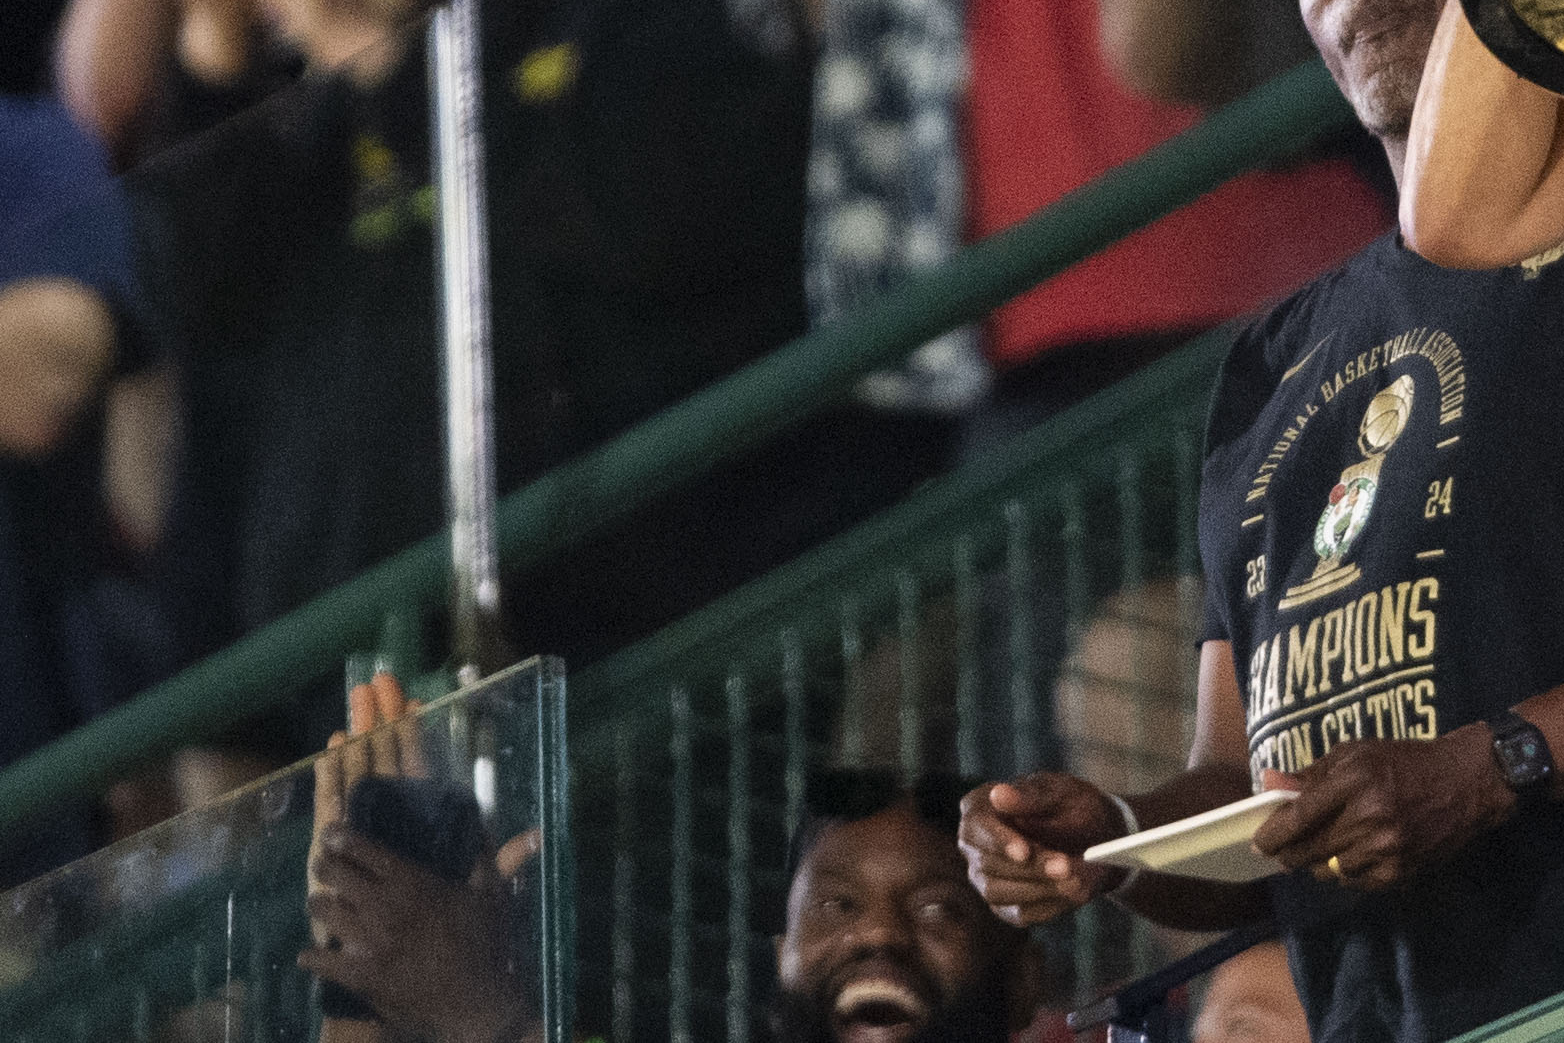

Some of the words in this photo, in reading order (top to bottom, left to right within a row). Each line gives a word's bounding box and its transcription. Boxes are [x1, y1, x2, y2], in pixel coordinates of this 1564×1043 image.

[1245, 403, 1319, 502] NATIONAL
[1320, 327, 1428, 403] BASKETBALL
[1419, 329, 1466, 426] ASSOCIATION
[1424, 476, 1453, 518] 24
[1246, 554, 1266, 599] 23
[1247, 576, 1439, 736] HAMPIONS
